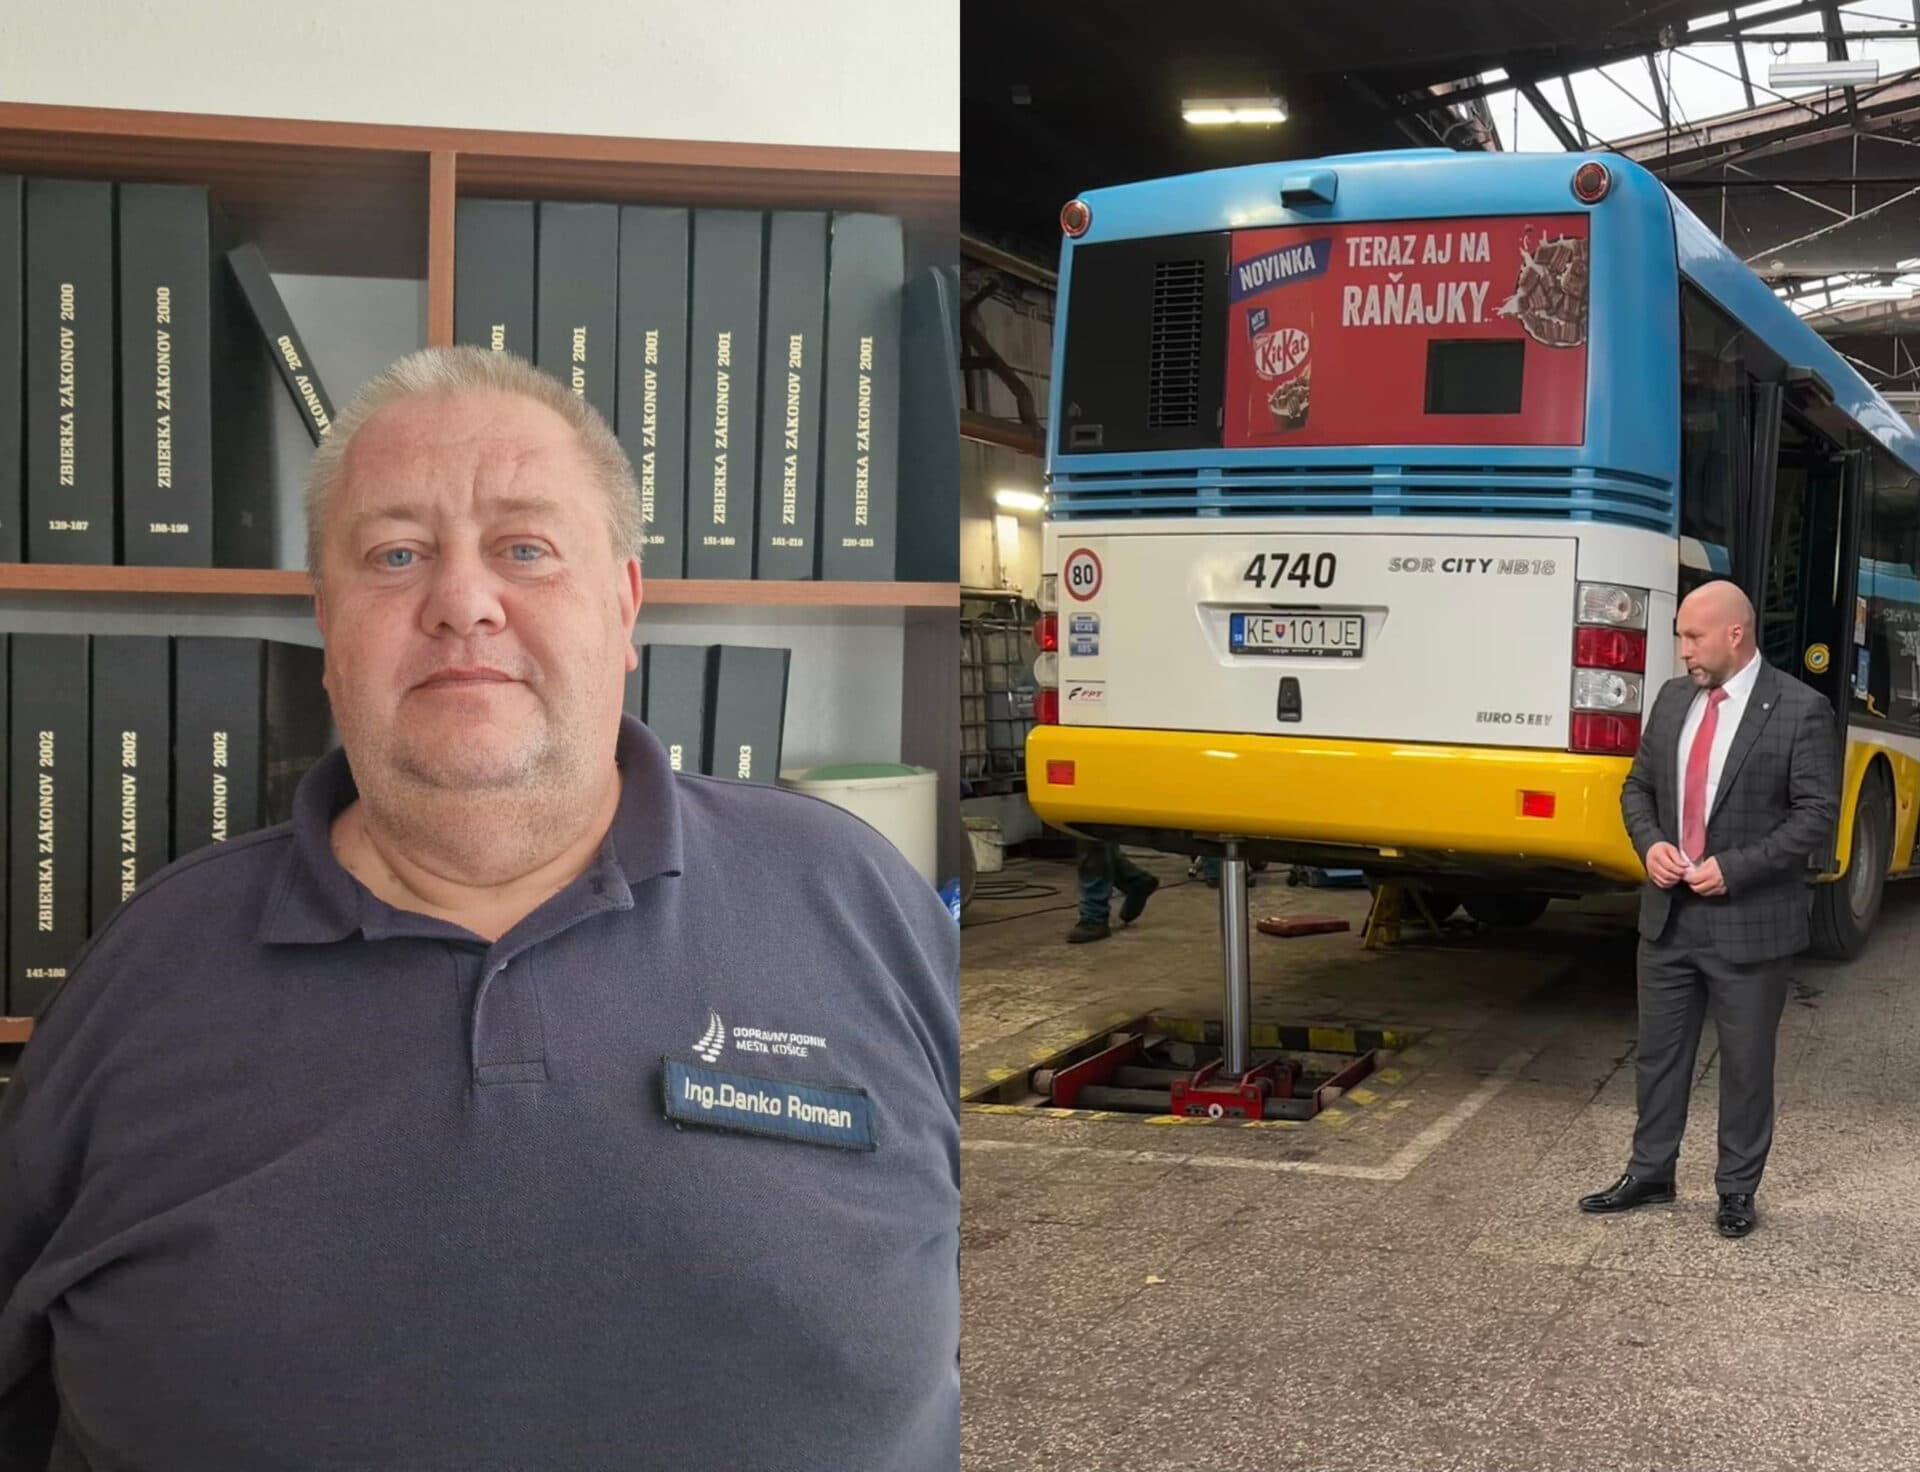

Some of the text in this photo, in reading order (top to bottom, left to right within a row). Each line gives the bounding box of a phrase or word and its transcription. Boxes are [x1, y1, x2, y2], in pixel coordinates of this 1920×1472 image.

[1346, 231, 1491, 268] TERAZ AJ NA
[1238, 245, 1316, 292] NOVINKA
[61, 284, 74, 320] 2000
[157, 287, 170, 323] 2000
[278, 335, 303, 371] 2000
[491, 323, 505, 351] 001
[573, 327, 586, 361] 2001
[645, 330, 658, 364] 2001
[718, 332, 731, 366] 2001
[789, 334, 802, 368] 2001
[860, 337, 872, 370] 2001
[1261, 329, 1306, 374] KitKat
[60, 413, 73, 485] ZBIERKA
[158, 415, 171, 488] ZBIERKA
[641, 452, 655, 523] ZBIERKA
[714, 454, 727, 524] ZBIERKA
[783, 455, 797, 524] ZBIERKA
[856, 456, 868, 525] ZBIERKA
[1072, 563, 1094, 586] 80
[1243, 553, 1336, 588] 4740
[1388, 557, 1556, 576] SOR CITY NB18
[1247, 619, 1357, 646] KE 101JE
[1476, 711, 1512, 724] EURO
[1514, 713, 1525, 724] 5
[39, 731, 53, 766] 2002
[122, 732, 136, 767] 2002
[214, 732, 227, 767] 2002
[669, 744, 682, 771] 003
[738, 745, 751, 778] 2003
[39, 859, 52, 931] ZBIERKA
[736, 1040, 770, 1053] MESTA
[789, 1033, 827, 1048] PODNIK
[684, 1077, 852, 1129] Ing.Danko Roman
